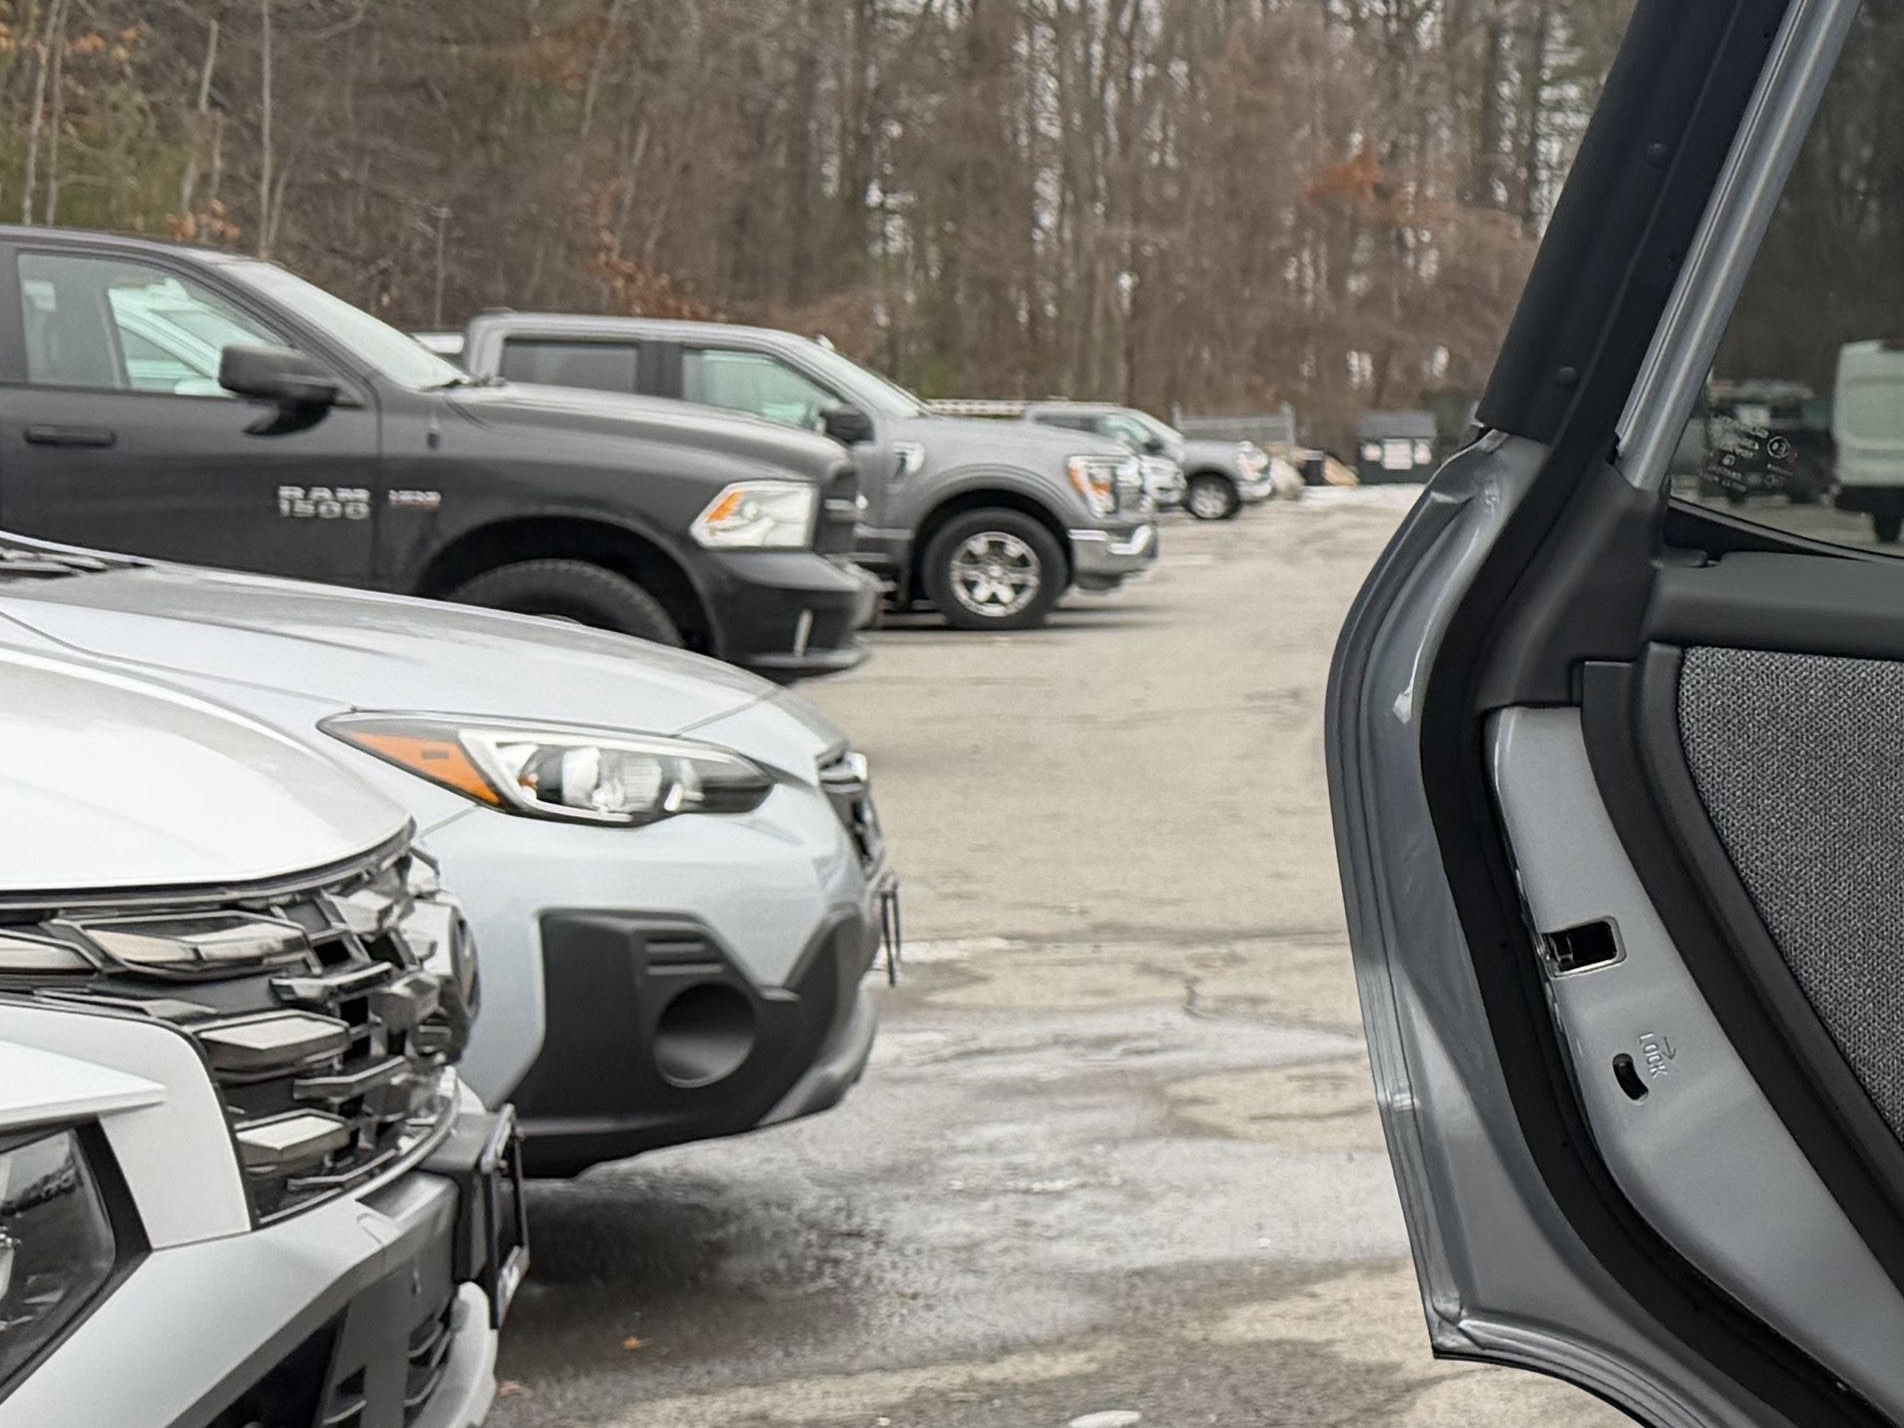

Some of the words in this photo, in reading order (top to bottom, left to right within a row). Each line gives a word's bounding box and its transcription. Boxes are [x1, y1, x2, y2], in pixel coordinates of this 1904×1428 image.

[278, 485, 370, 501] RAM
[279, 498, 370, 519] 1500
[1639, 1032, 1668, 1079] LOCK
